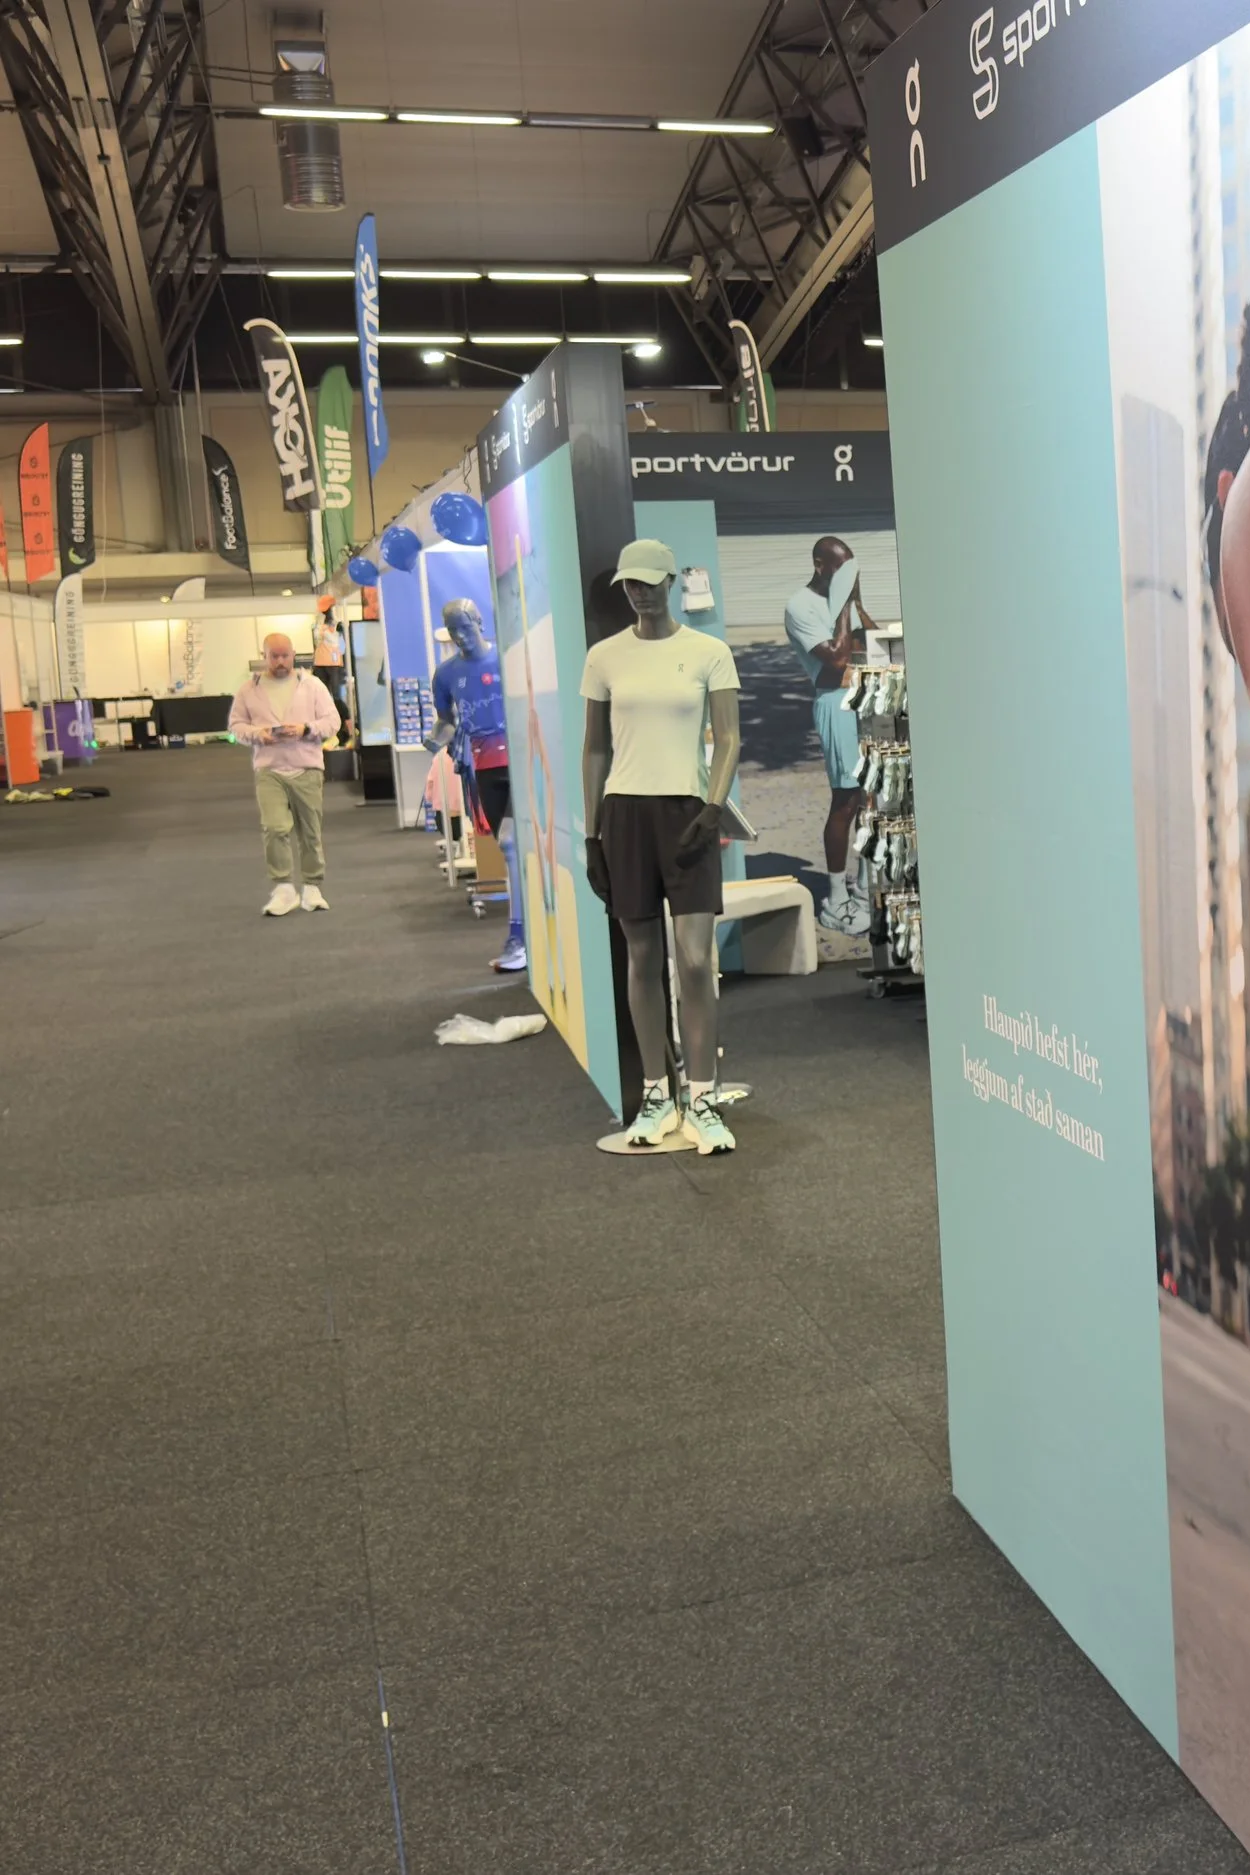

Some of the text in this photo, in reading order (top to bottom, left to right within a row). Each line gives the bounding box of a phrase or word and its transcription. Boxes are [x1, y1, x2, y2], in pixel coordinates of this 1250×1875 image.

[261, 358, 316, 501] HOKA
[220, 472, 237, 550] FootBalance
[983, 994, 1103, 1095] Hlaupið hefst hér,
[961, 1043, 1105, 1161] leggjum af stað saman
